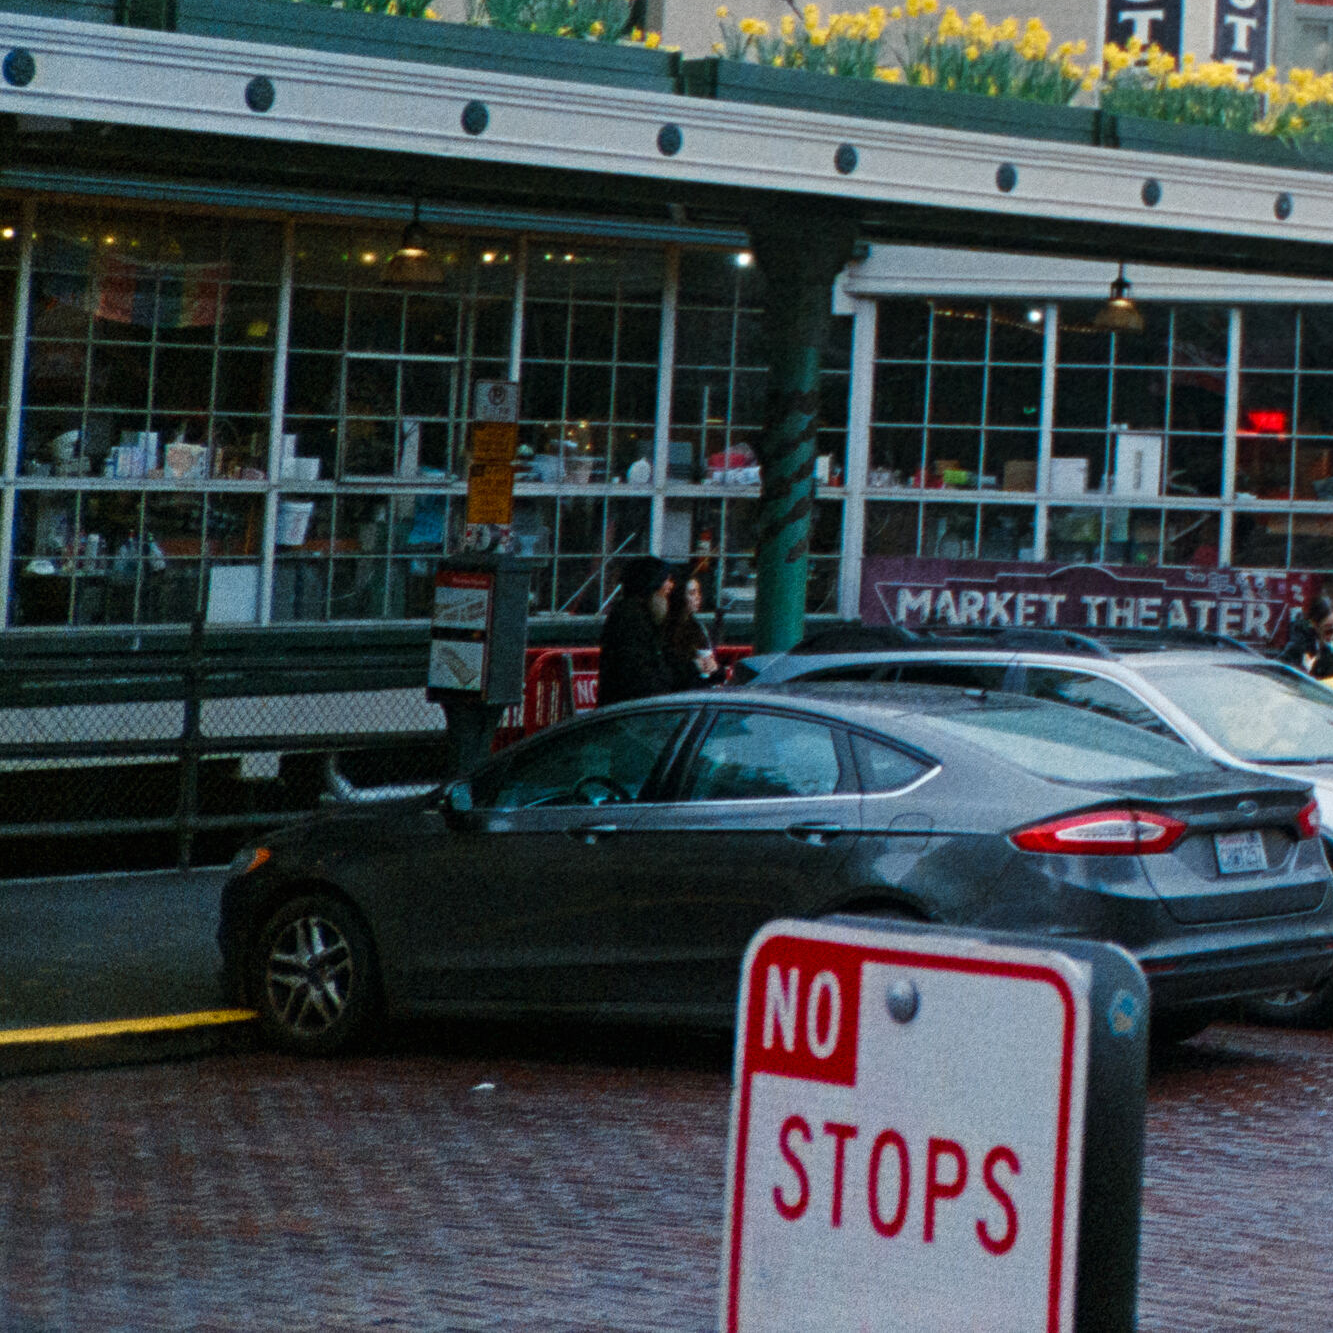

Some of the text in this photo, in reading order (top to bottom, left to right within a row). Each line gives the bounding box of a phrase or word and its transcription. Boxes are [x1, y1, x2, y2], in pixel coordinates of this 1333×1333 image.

[898, 586, 1272, 638] MARKET THEATER
[762, 962, 842, 1060] NO
[772, 1114, 1022, 1257] STOPS
